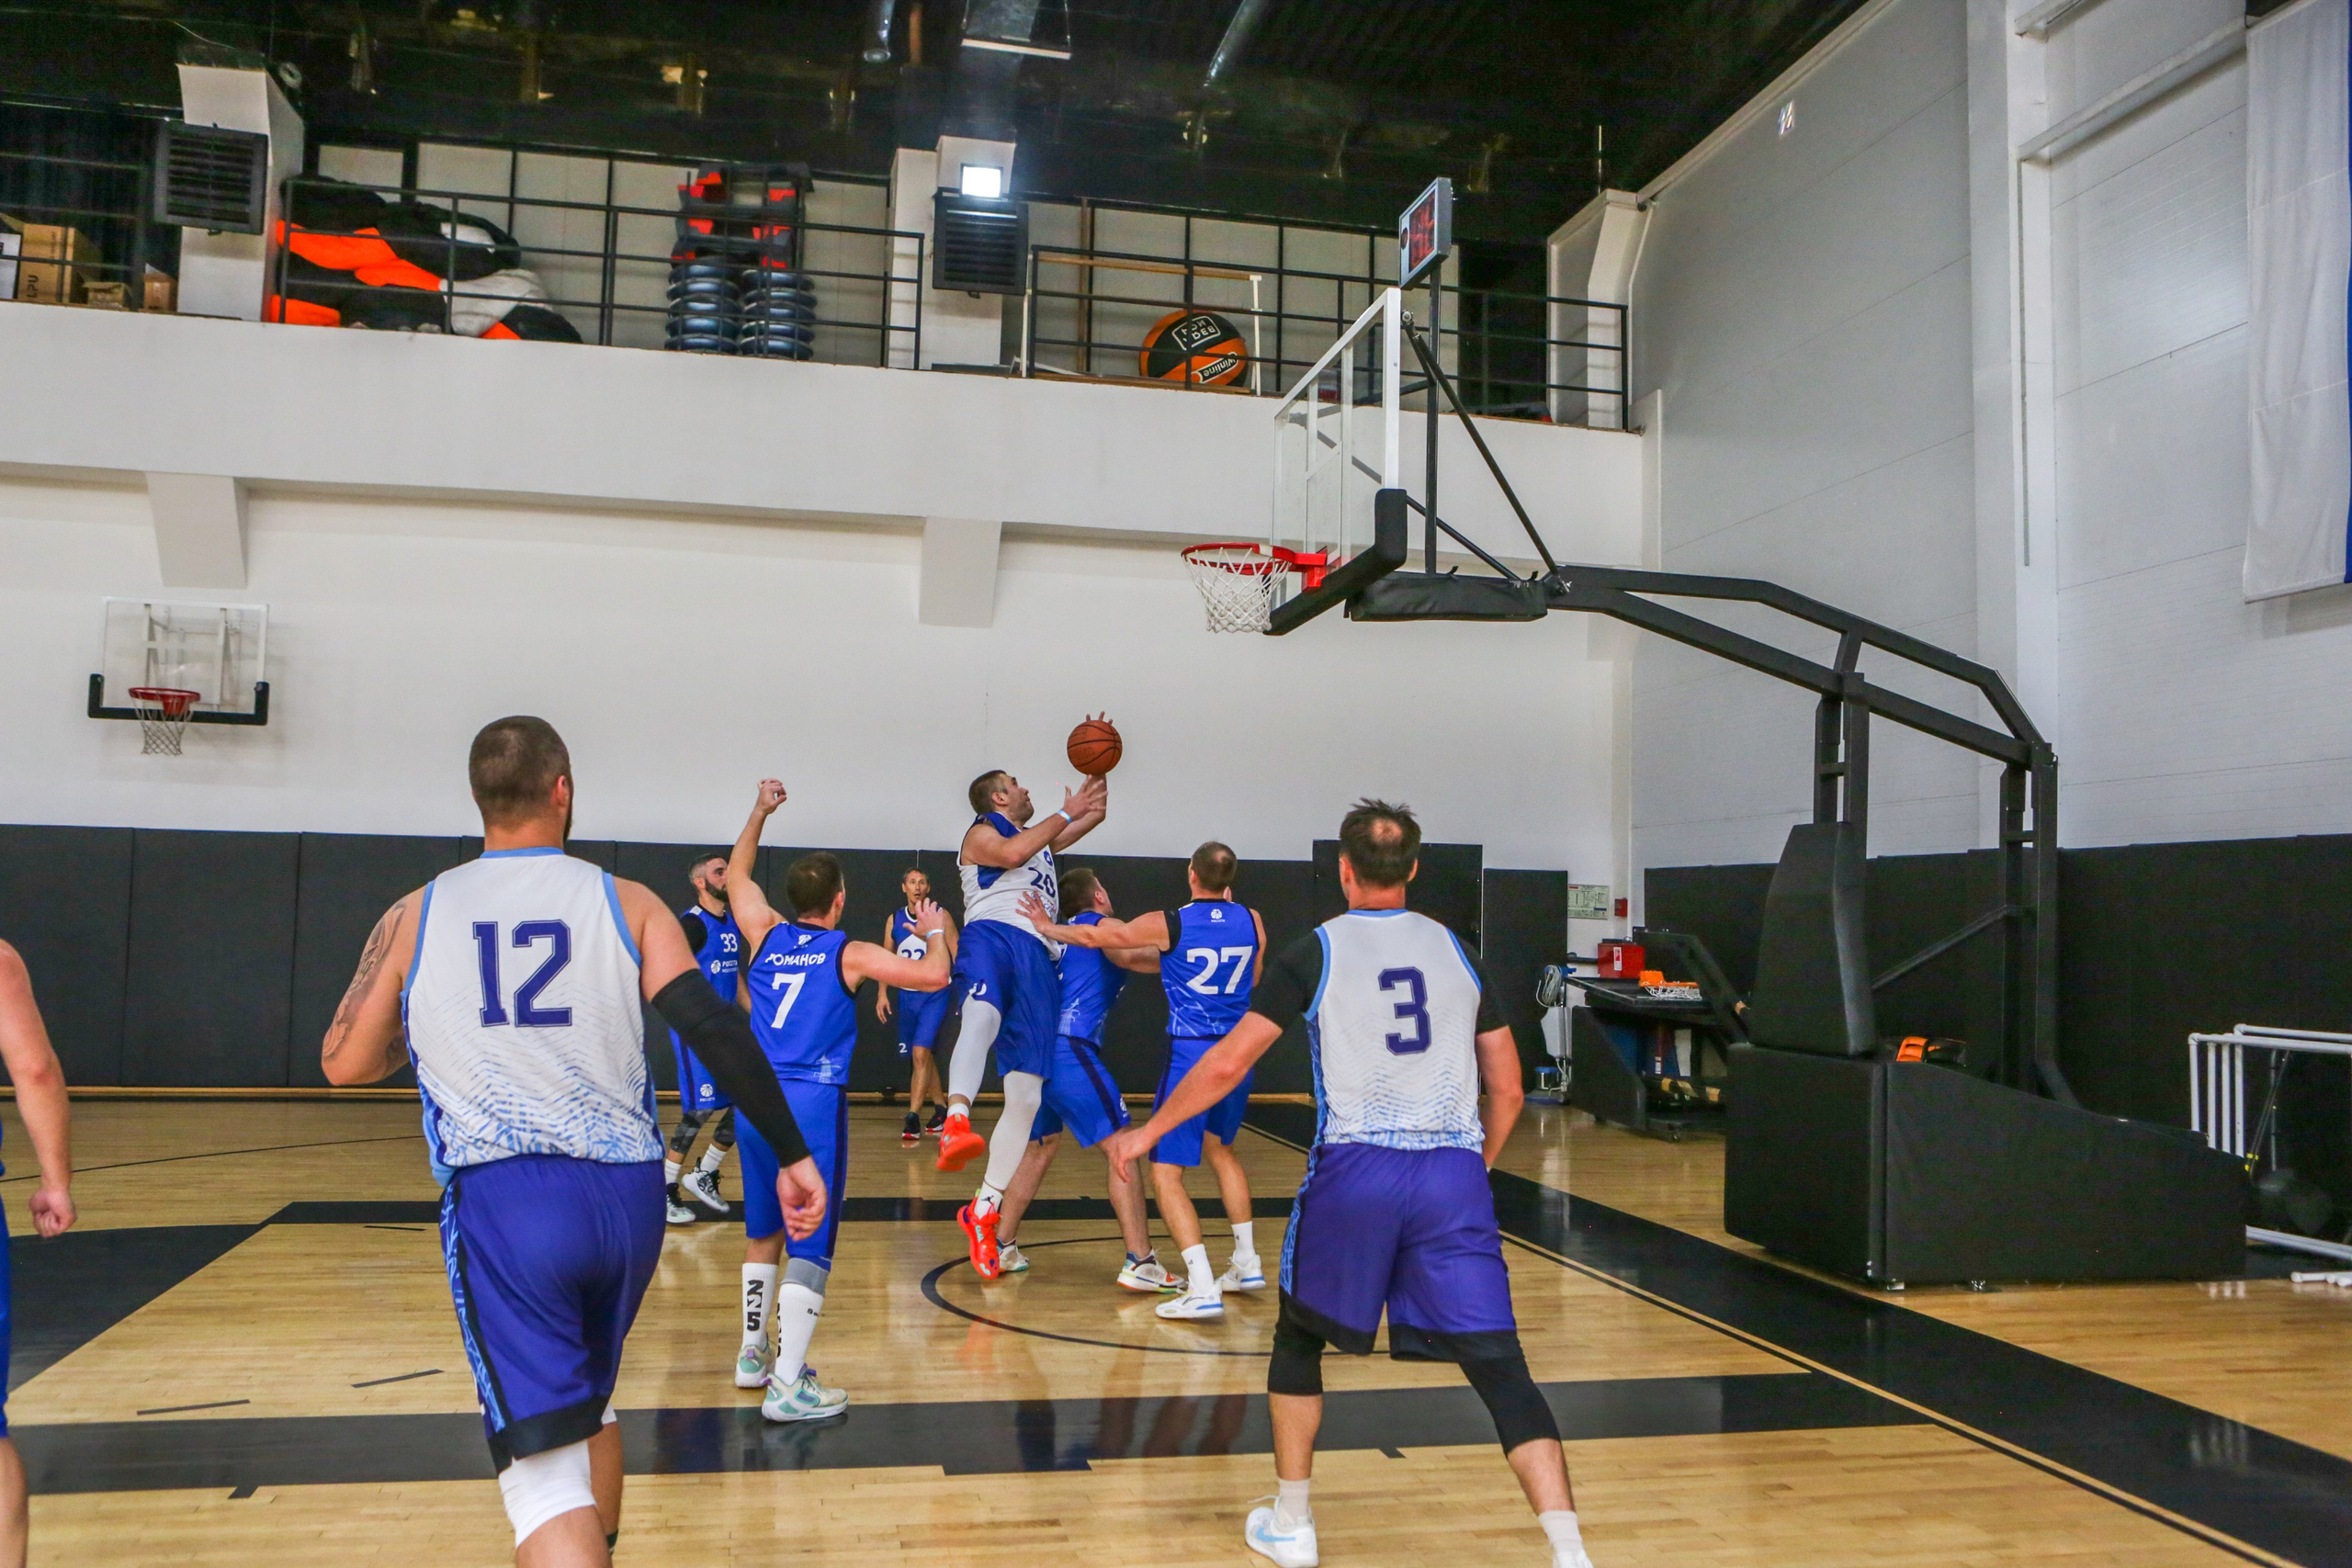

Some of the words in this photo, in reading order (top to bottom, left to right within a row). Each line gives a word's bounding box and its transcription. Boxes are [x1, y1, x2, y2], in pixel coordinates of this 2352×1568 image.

[1027, 866, 1057, 898] 20
[719, 932, 739, 953] 33
[472, 919, 572, 1028] 12
[1186, 945, 1253, 995] 27
[771, 972, 807, 1030] 7
[1377, 966, 1432, 1055] 3
